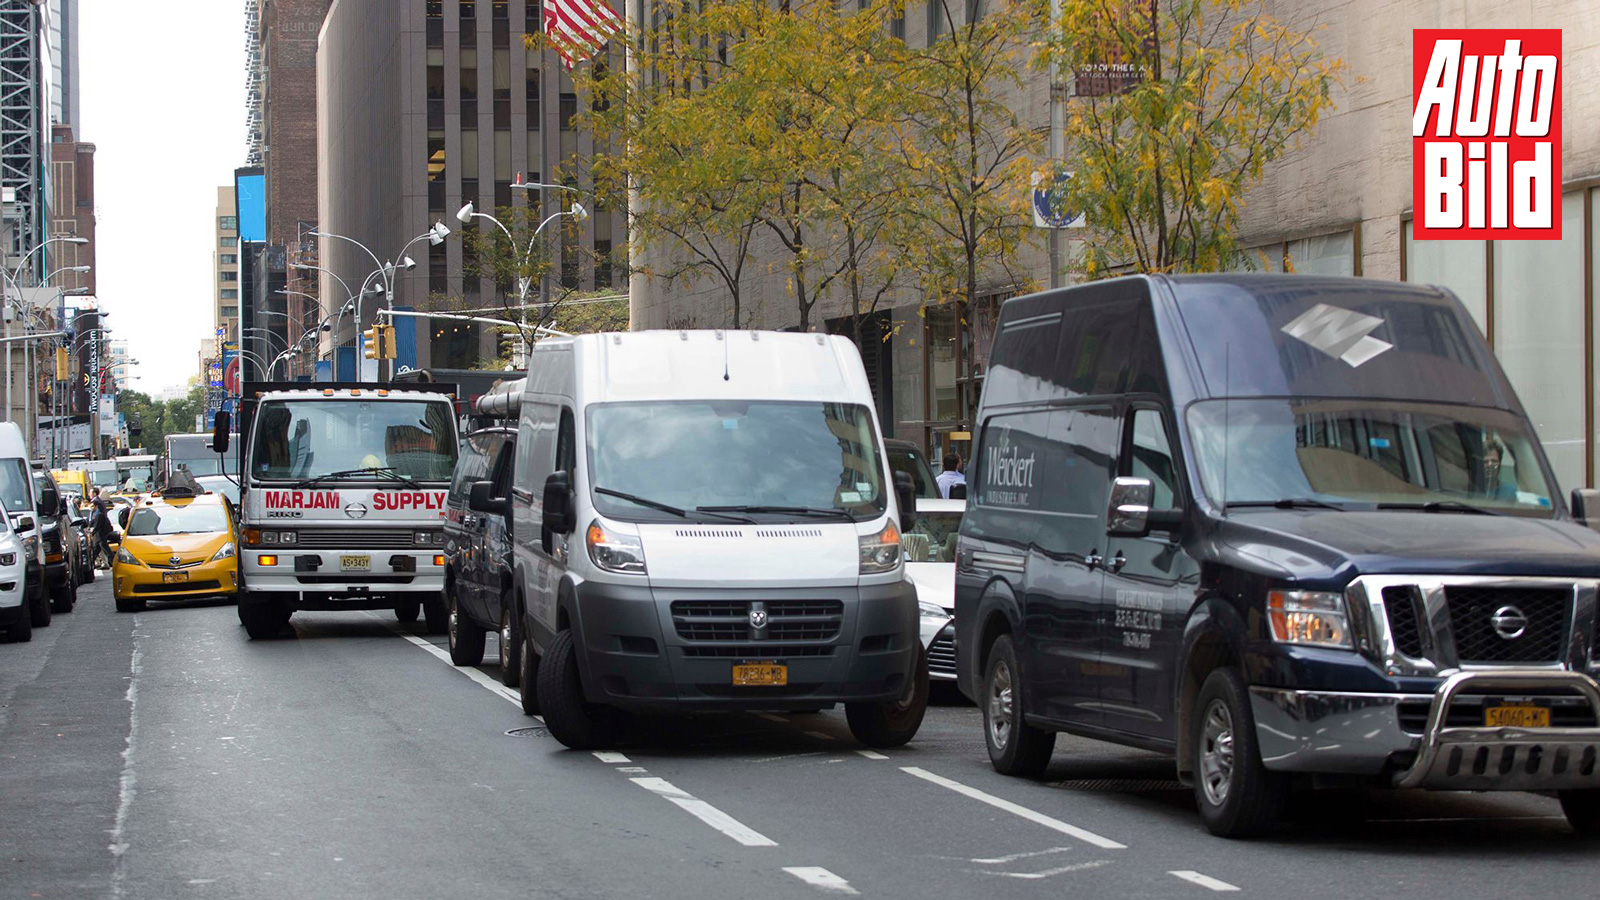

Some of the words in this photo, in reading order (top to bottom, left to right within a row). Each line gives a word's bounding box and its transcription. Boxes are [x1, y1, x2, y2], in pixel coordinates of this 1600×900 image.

[1112, 63, 1128, 72] THE
[988, 446, 1035, 488] Weickert
[265, 491, 340, 510] MARJAM
[373, 491, 446, 511] SUPPLY
[267, 510, 304, 518] HINO
